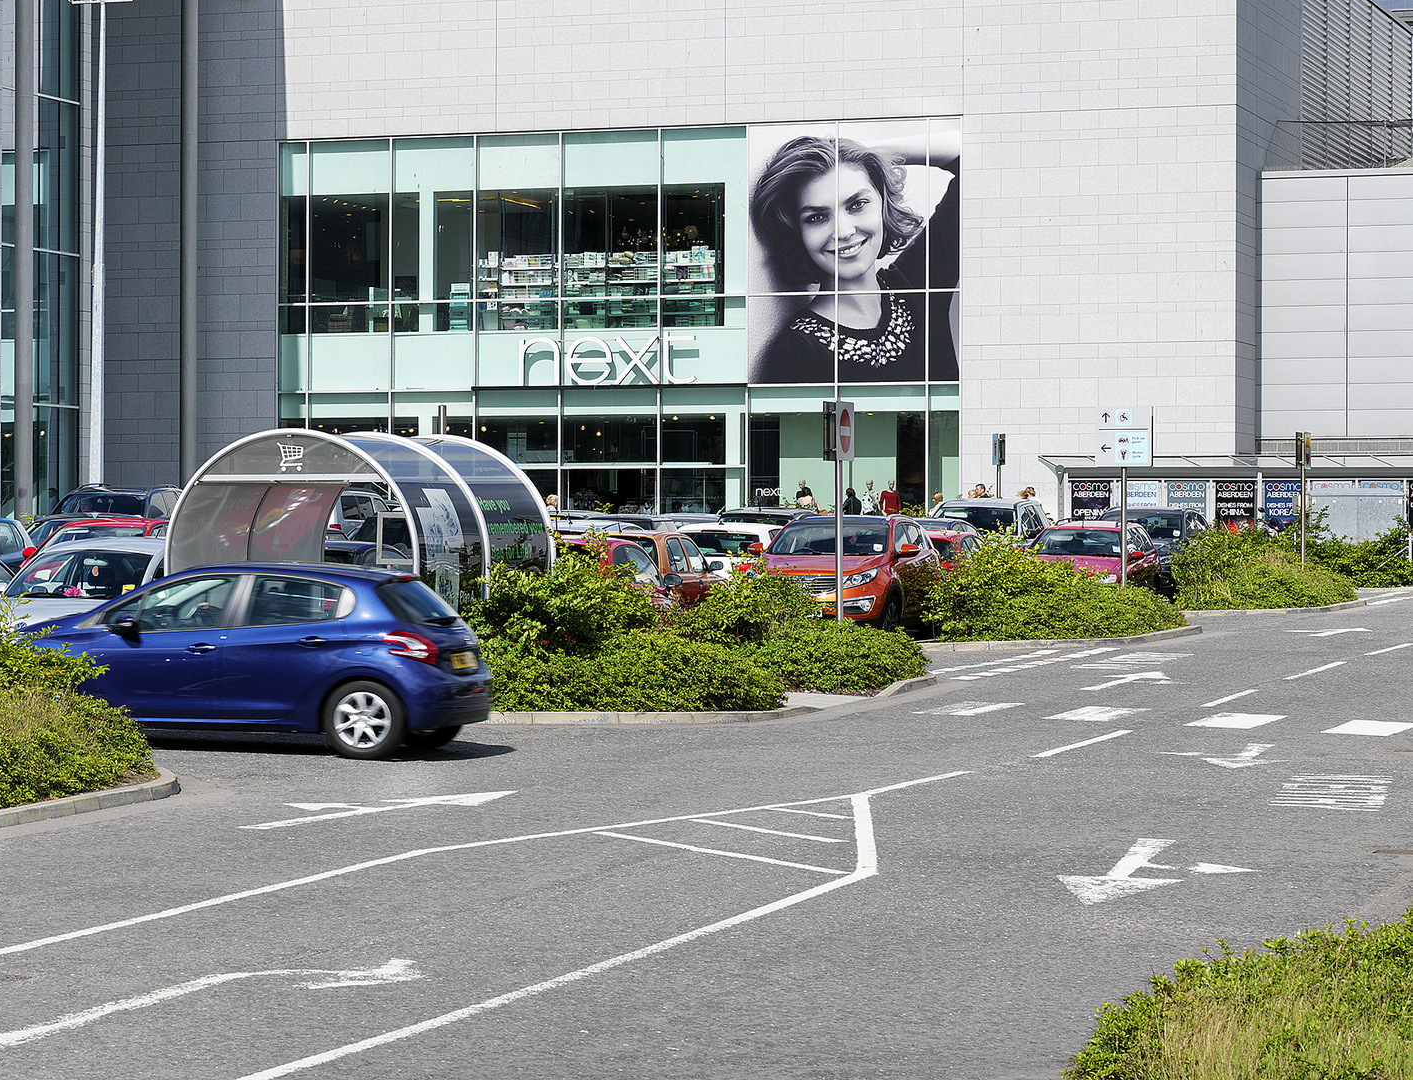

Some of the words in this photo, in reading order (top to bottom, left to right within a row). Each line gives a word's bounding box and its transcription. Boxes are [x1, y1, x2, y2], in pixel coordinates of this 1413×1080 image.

[518, 331, 697, 387] next
[755, 487, 783, 497] next
[475, 496, 497, 511] Have
[495, 499, 511, 514] you
[487, 519, 528, 535] remembered
[528, 523, 544, 537] your
[491, 543, 505, 561] Bag
[506, 543, 516, 560] for
